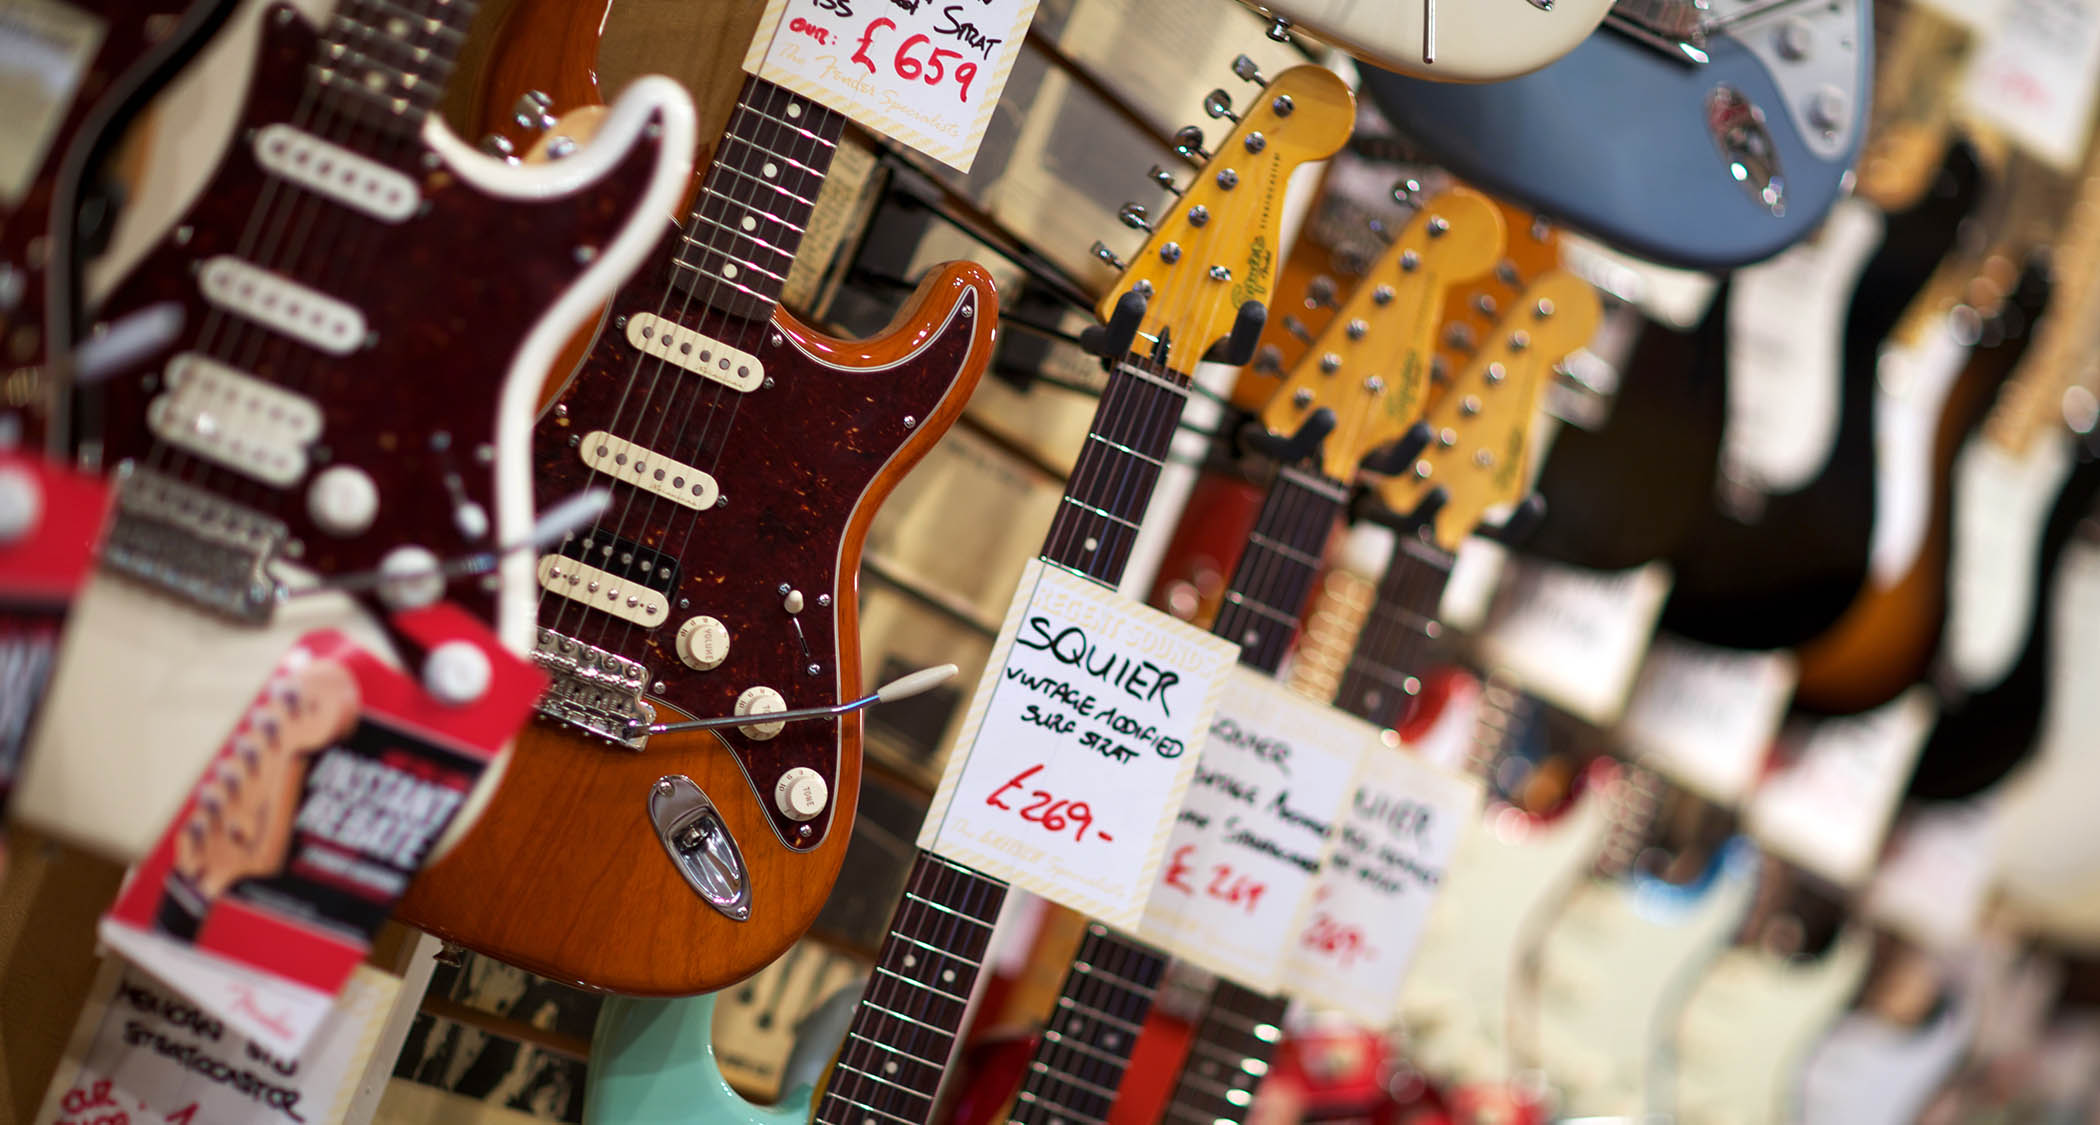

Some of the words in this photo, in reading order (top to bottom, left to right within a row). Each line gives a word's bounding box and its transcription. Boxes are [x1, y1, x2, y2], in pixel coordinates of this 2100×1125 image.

[815, 55, 876, 97] Fender
[1006, 666, 1096, 717] VINTAGE
[1015, 617, 1180, 718] SQUIER
[1020, 704, 1078, 735] SURF
[1078, 729, 1141, 765] STRAT
